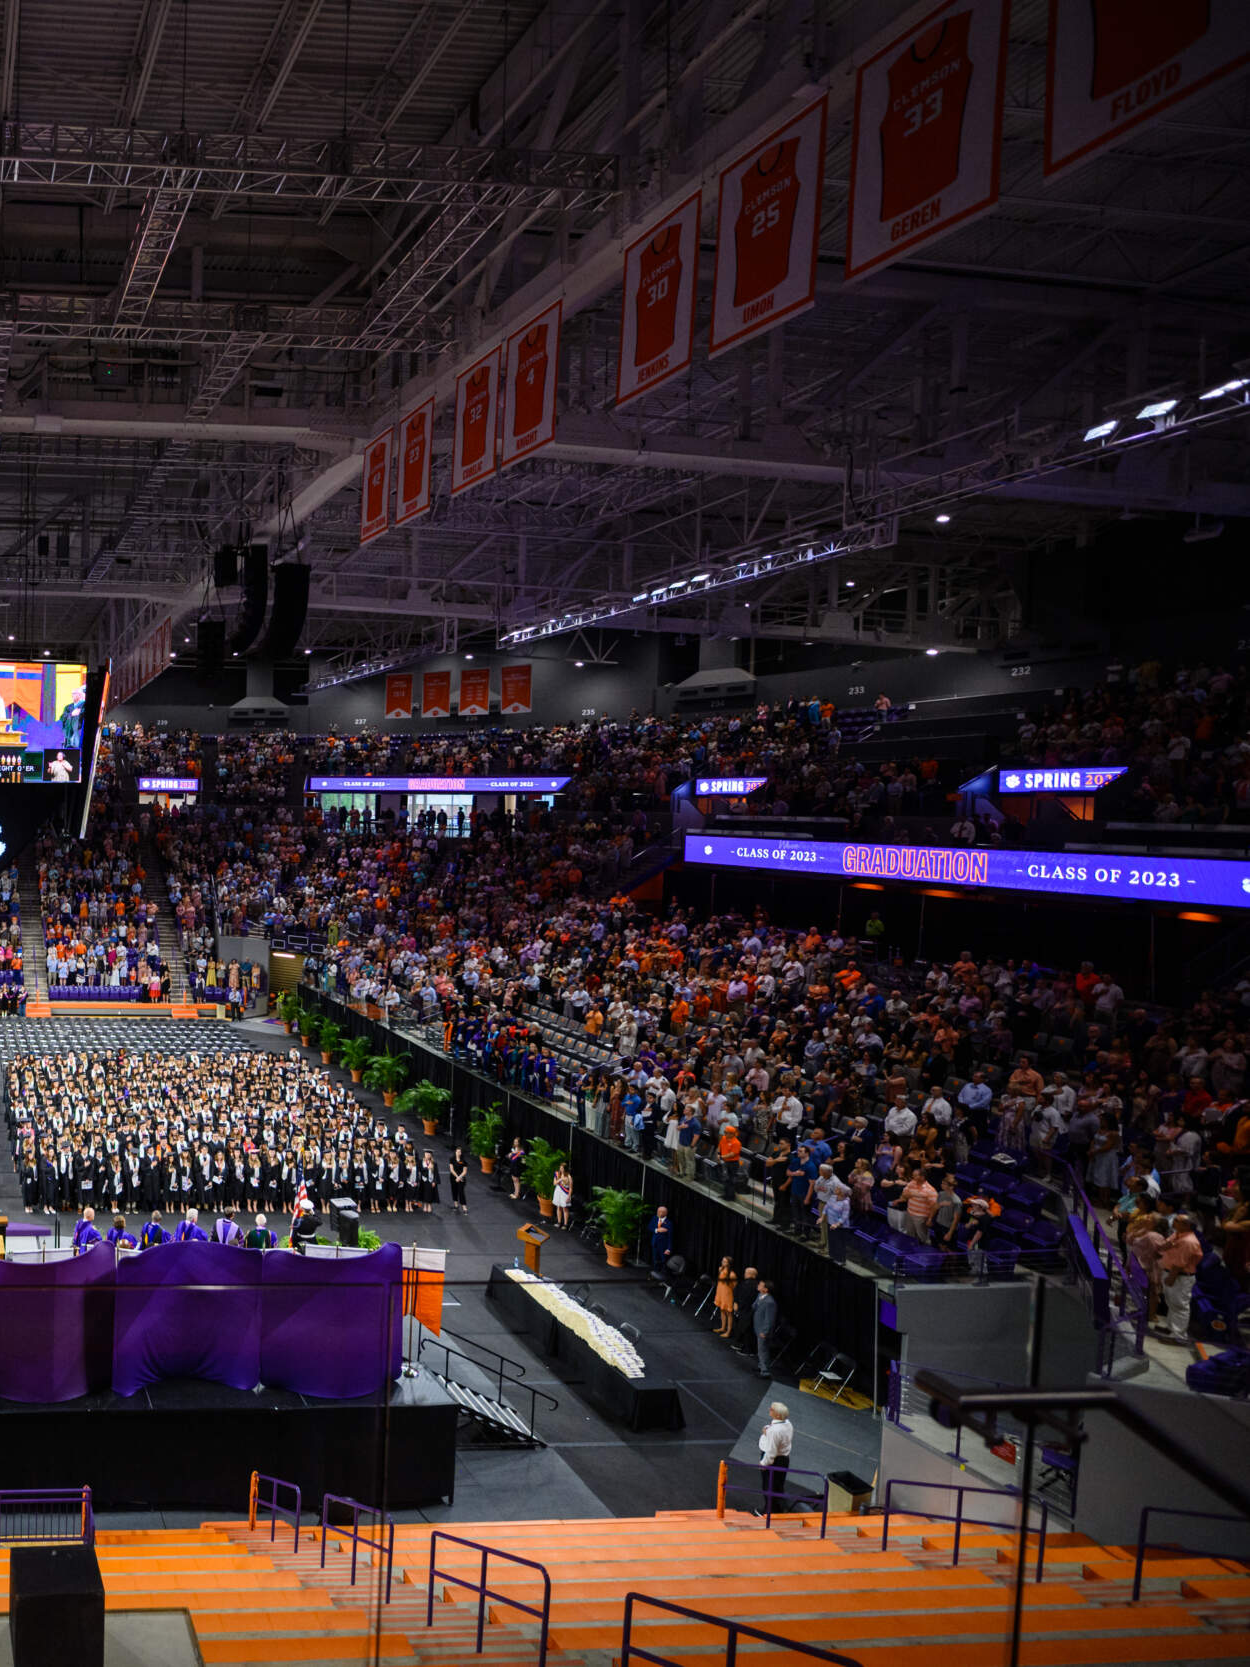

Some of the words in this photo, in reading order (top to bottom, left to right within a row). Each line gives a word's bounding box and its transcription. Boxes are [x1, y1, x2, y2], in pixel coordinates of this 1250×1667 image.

[894, 58, 963, 112] CLEMSON
[1111, 63, 1182, 121] FLOYD
[903, 88, 944, 138] 33
[743, 176, 792, 216] CLEMSON
[751, 200, 780, 239] 25
[891, 198, 941, 241] GEREN
[647, 276, 669, 308] 30
[526, 367, 535, 385] 4
[638, 354, 669, 384] JENKINS
[1011, 665, 1031, 677] 232
[848, 686, 865, 696] 233
[581, 709, 595, 717] 235
[152, 780, 178, 789] SPRING
[711, 780, 744, 792] SPRING
[1024, 771, 1081, 789] SPRING
[1085, 774, 1121, 786] 202
[737, 847, 770, 859] CLASS
[772, 849, 787, 860] OF
[790, 850, 817, 862] 2023
[843, 846, 988, 883] GRADUATION
[1027, 864, 1087, 881] CLASS
[1095, 868, 1122, 883] OF
[1129, 870, 1180, 887] 2023
